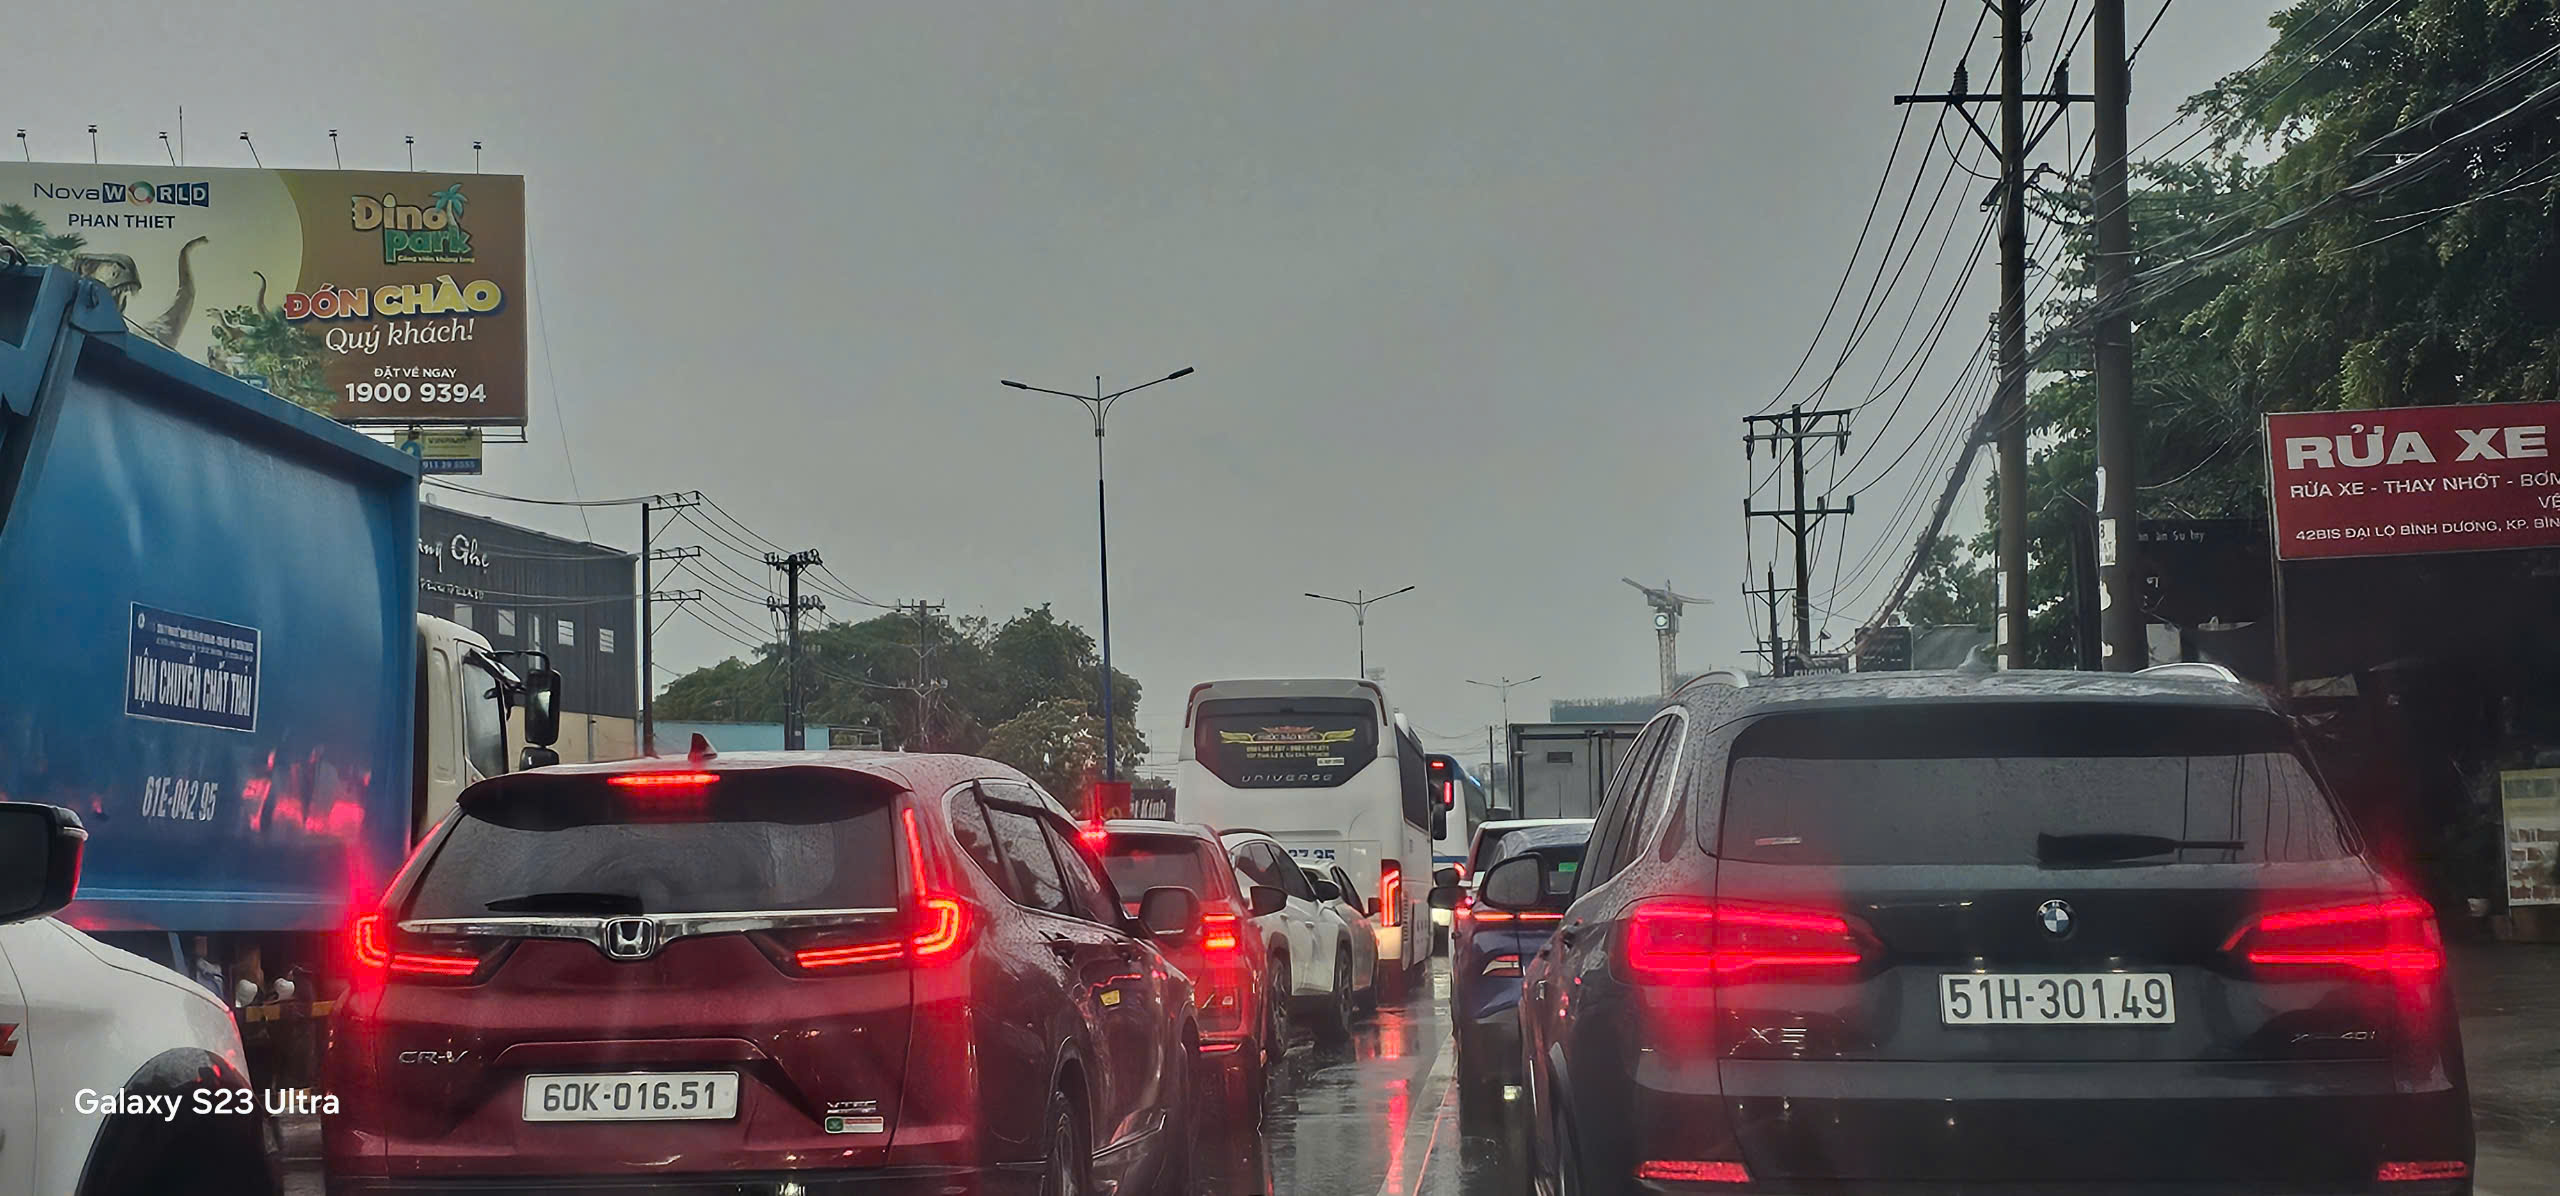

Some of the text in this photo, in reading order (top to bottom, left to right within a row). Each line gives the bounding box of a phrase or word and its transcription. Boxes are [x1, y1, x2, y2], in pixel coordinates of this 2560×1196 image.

[69, 213, 176, 229] PHAN THIET
[351, 192, 450, 231] Dino
[383, 228, 472, 264] park
[283, 273, 502, 320] ĐÓN CHÀO
[325, 317, 475, 355] Quý khách!
[374, 365, 400, 379] ĐẶT
[422, 368, 457, 379] NGAY
[345, 382, 487, 403] 1900 9394
[2285, 423, 2548, 470] RỬA XE
[2290, 480, 2333, 498] RỬA
[2337, 482, 2365, 497] XE
[2383, 478, 2436, 494] THAY
[2295, 528, 2341, 541] 42BIS
[2345, 526, 2371, 541] ĐẠI
[2400, 522, 2438, 536] BÌNH
[2506, 518, 2529, 531] KP.
[134, 647, 158, 709] VẬN
[158, 652, 202, 710] CHUYỂN
[202, 660, 230, 714] CHẤT
[230, 665, 253, 717] THẢI
[1948, 978, 2168, 1020] 51H-301.49
[399, 1050, 469, 1065] CR-V
[543, 1081, 716, 1113] 60K-016.51
